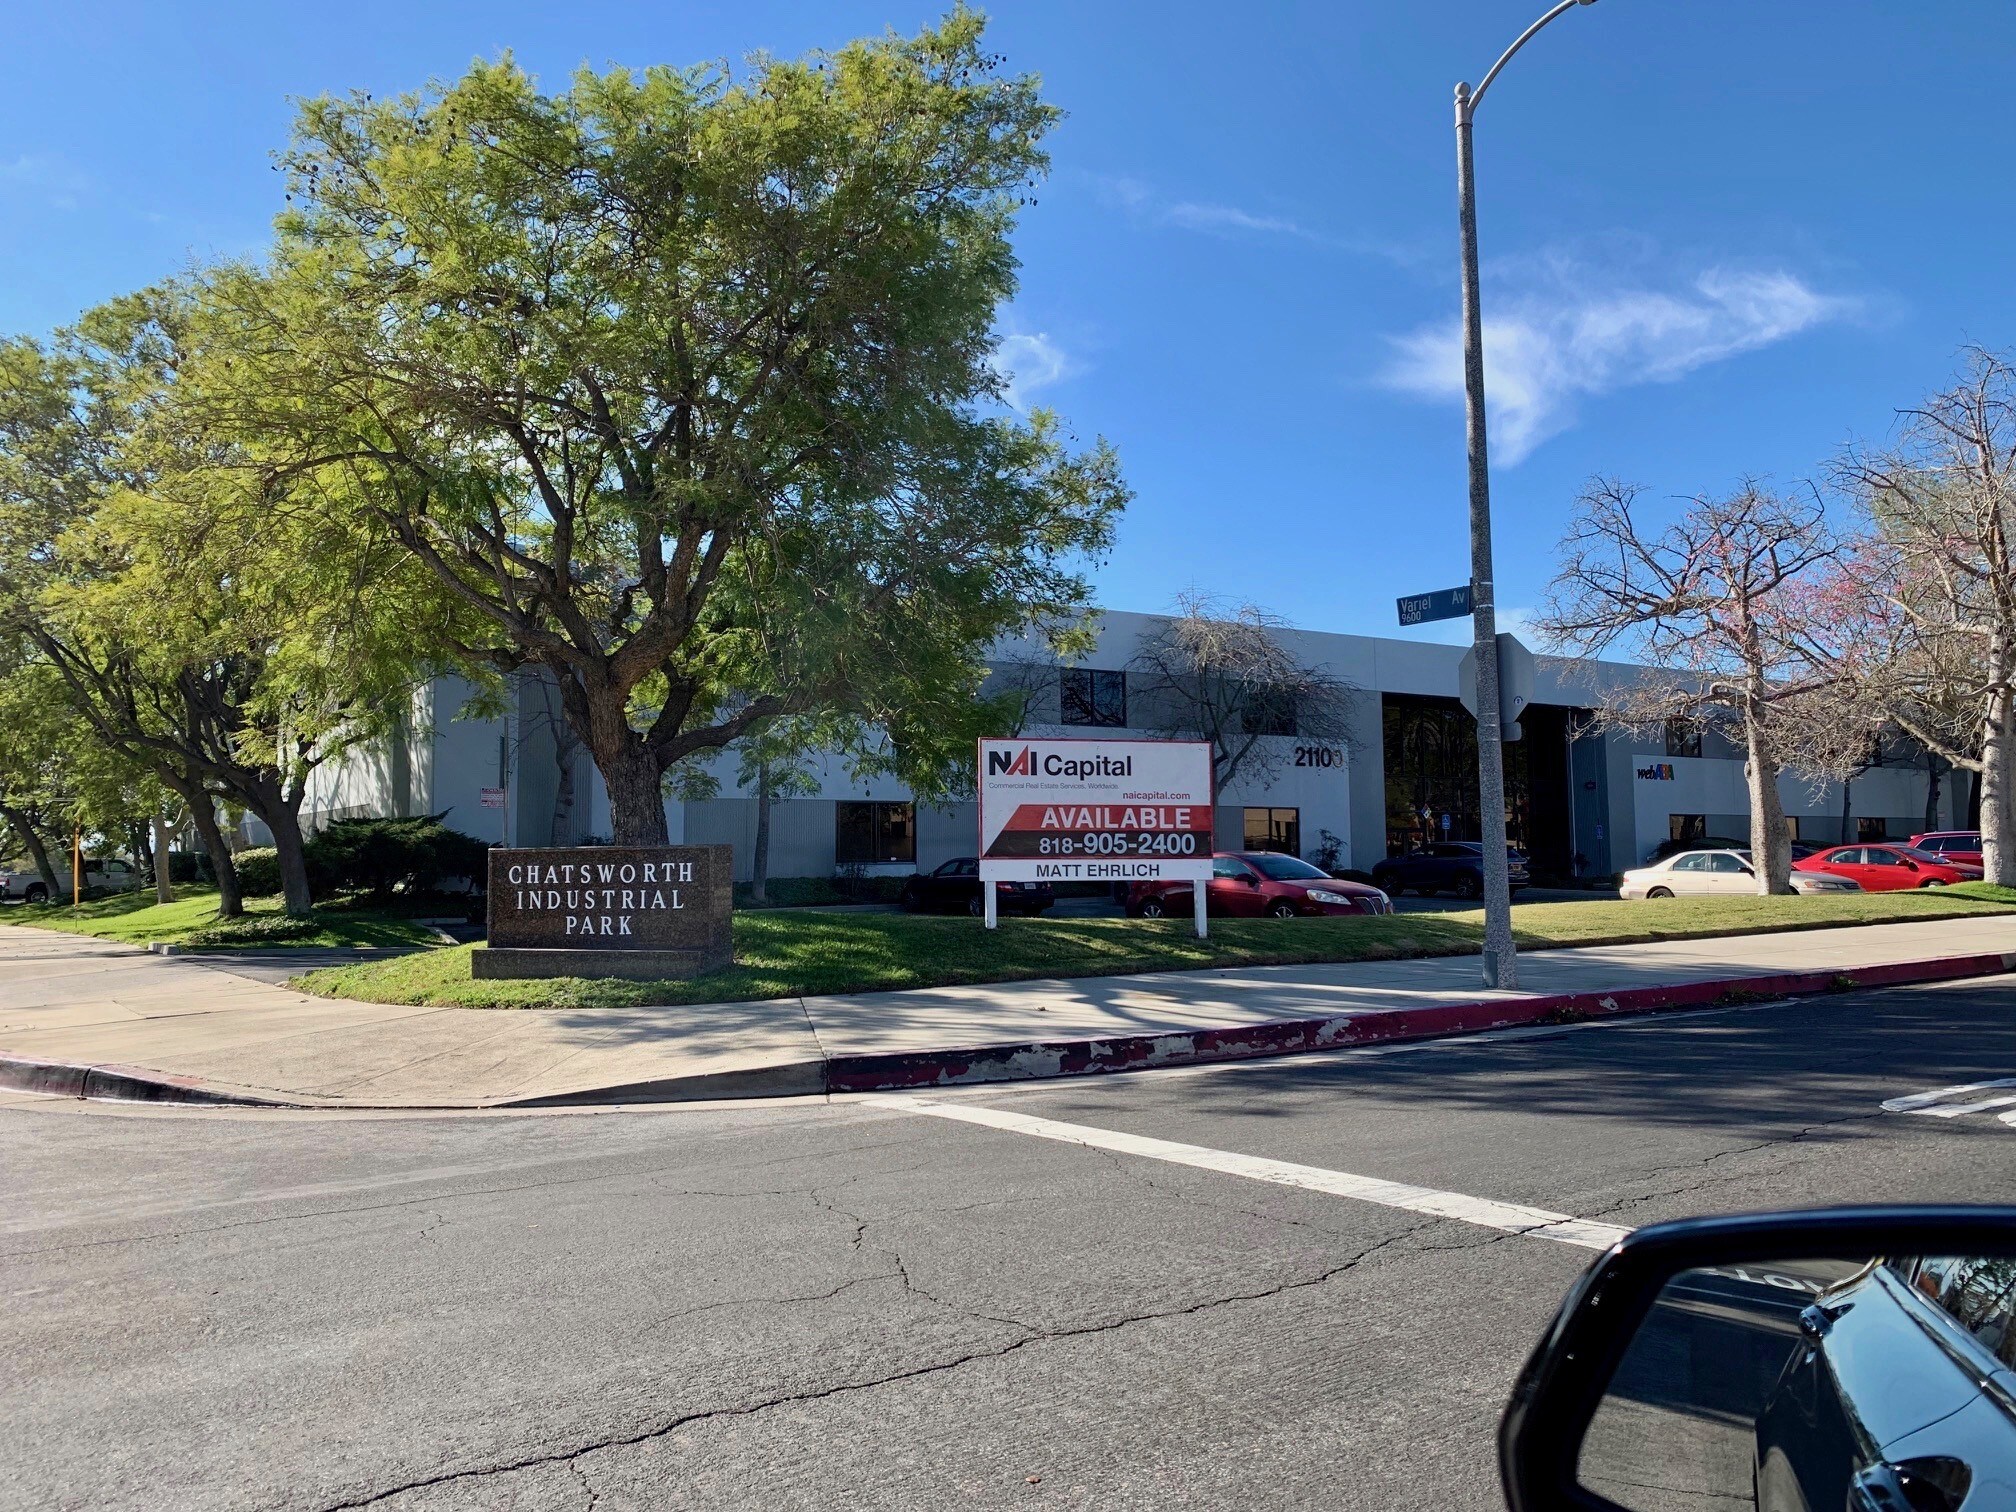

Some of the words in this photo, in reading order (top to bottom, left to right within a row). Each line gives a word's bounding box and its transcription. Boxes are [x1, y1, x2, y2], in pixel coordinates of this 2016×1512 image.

[1400, 596, 1432, 614] Variel
[1451, 590, 1465, 606] Av
[1401, 611, 1422, 623] 9600
[988, 744, 1038, 776] NAI
[1043, 754, 1132, 781] Capital
[988, 782, 1025, 790] Commercial
[1025, 782, 1039, 790] Real
[1040, 782, 1059, 790] Estate
[1122, 791, 1191, 802] naicapital.com
[1041, 807, 1191, 829] AVAILABLE
[1039, 833, 1196, 855] 818-905-2400
[508, 862, 693, 884] CHATSWORTH
[1036, 864, 1082, 878] MATT
[1087, 864, 1160, 877] EHRLICH
[517, 889, 684, 910] INDUSTRIAL
[565, 915, 633, 936] PARK
